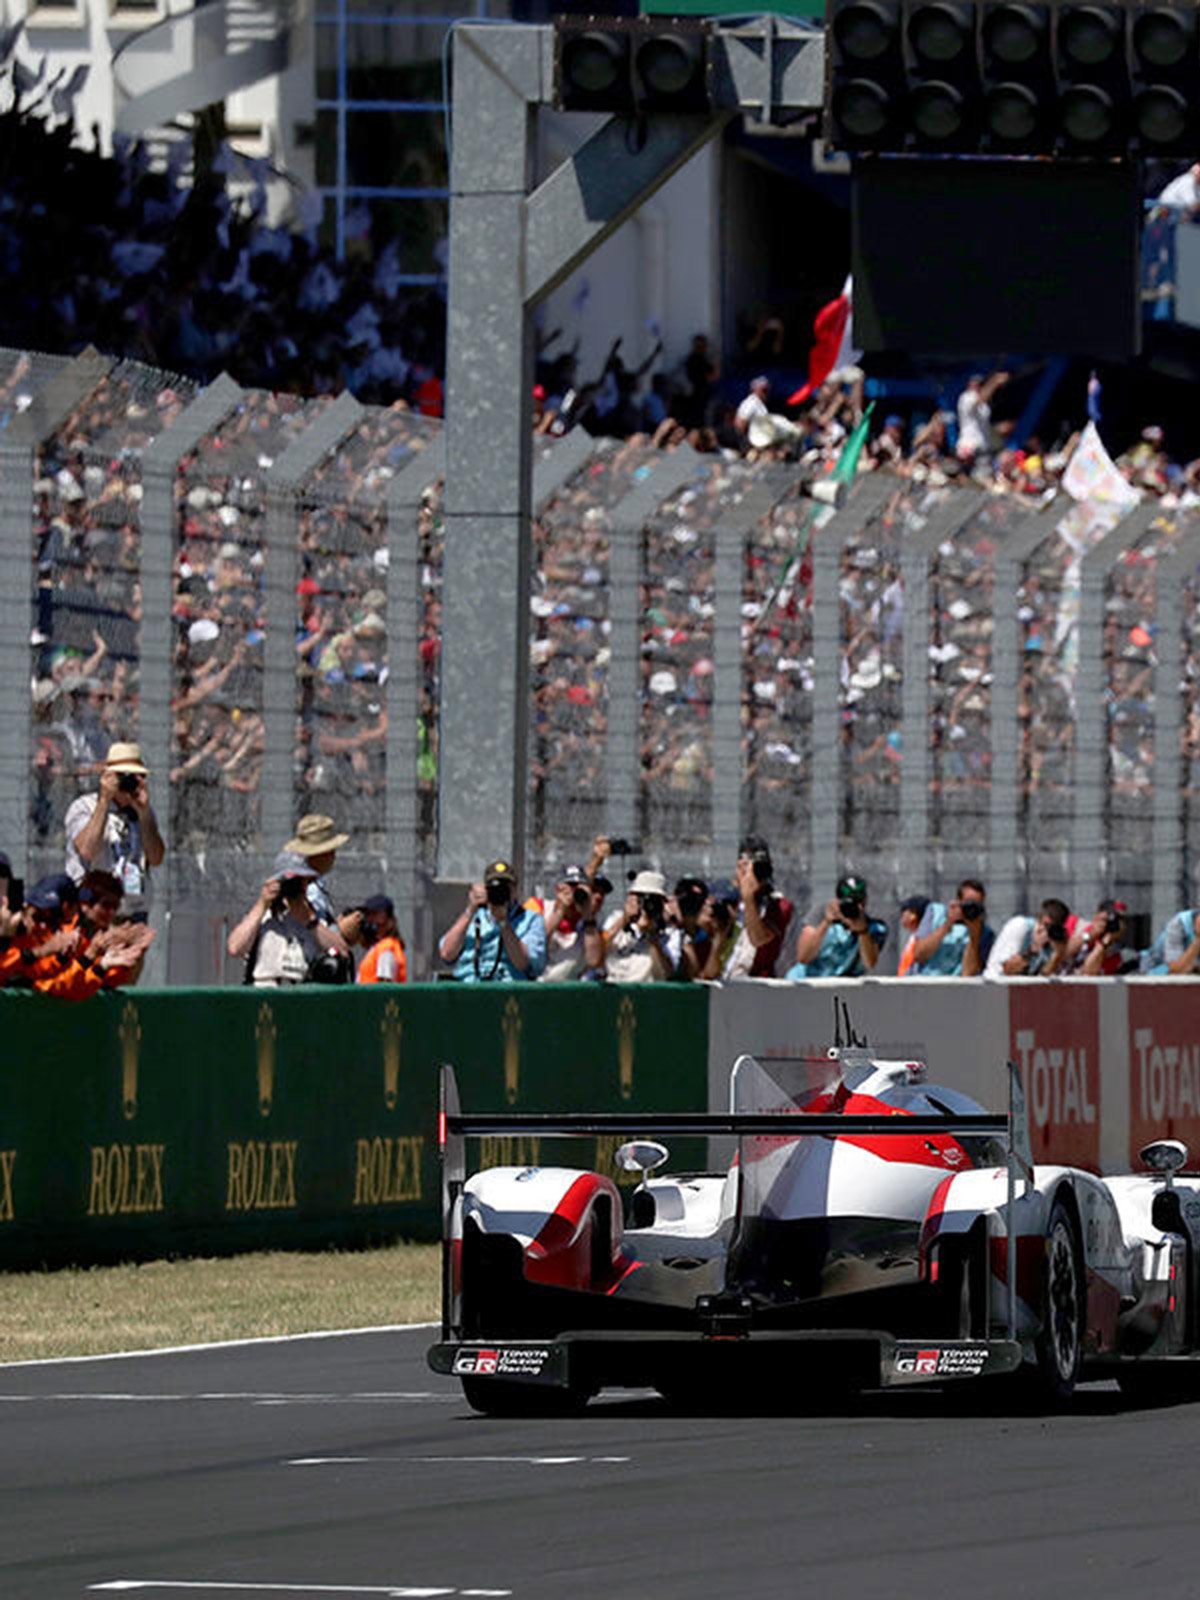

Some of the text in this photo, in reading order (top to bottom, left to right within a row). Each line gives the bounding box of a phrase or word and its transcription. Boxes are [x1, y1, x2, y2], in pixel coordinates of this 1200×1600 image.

[1016, 1029, 1096, 1127] TOTAL
[226, 1141, 297, 1209] ROLEX
[353, 1136, 424, 1204] ROLEX
[87, 1144, 165, 1215] ROLEX
[501, 1350, 548, 1358] TOYOTA
[456, 1358, 497, 1374] GR
[497, 1365, 540, 1374] Racing
[896, 1358, 939, 1374] GR
[938, 1365, 981, 1374] Racing
